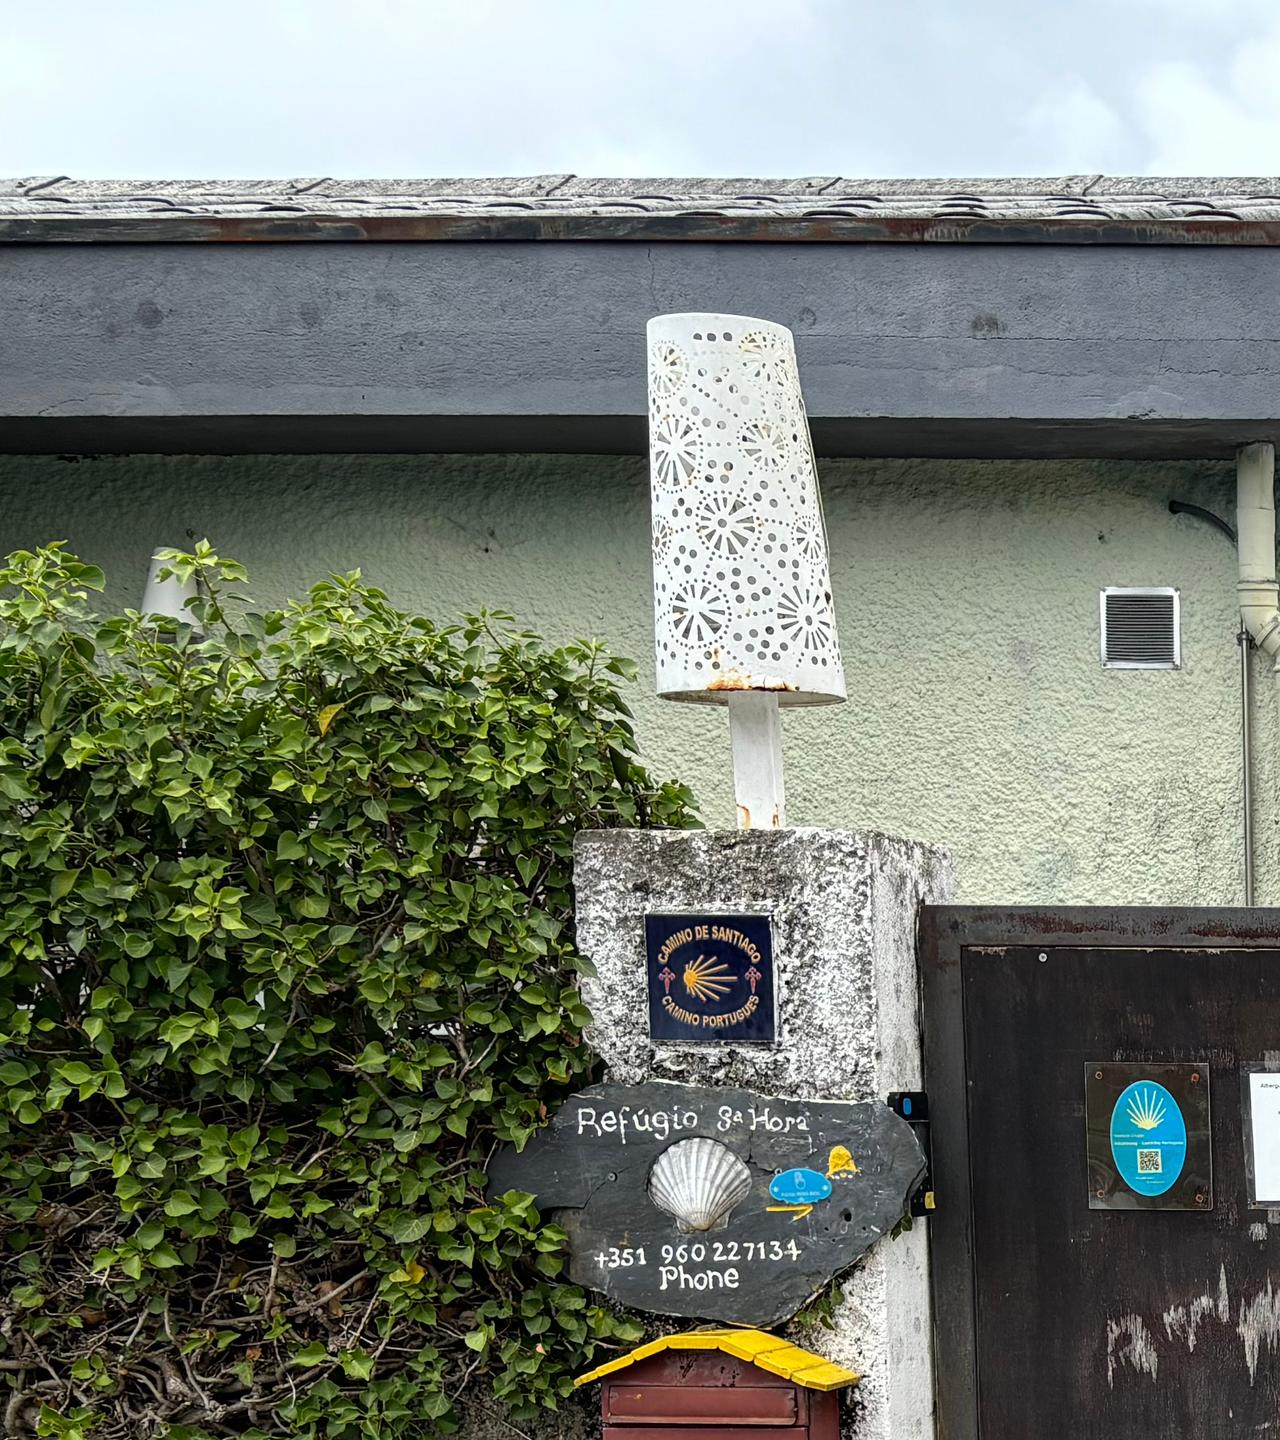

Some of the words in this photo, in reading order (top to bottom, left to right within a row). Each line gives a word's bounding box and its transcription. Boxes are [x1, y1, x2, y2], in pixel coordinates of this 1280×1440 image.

[658, 928, 693, 964] CAMINO
[695, 925, 709, 940] DE
[712, 926, 761, 964] SANTIAGO
[662, 995, 700, 1026] CAMINO
[702, 995, 759, 1028] PORTUGUES
[577, 1106, 699, 1144] Refúgio
[594, 1248, 647, 1269] +351
[661, 1244, 706, 1264] 960
[712, 1238, 802, 1261] 227134
[658, 1264, 740, 1291] Phone
